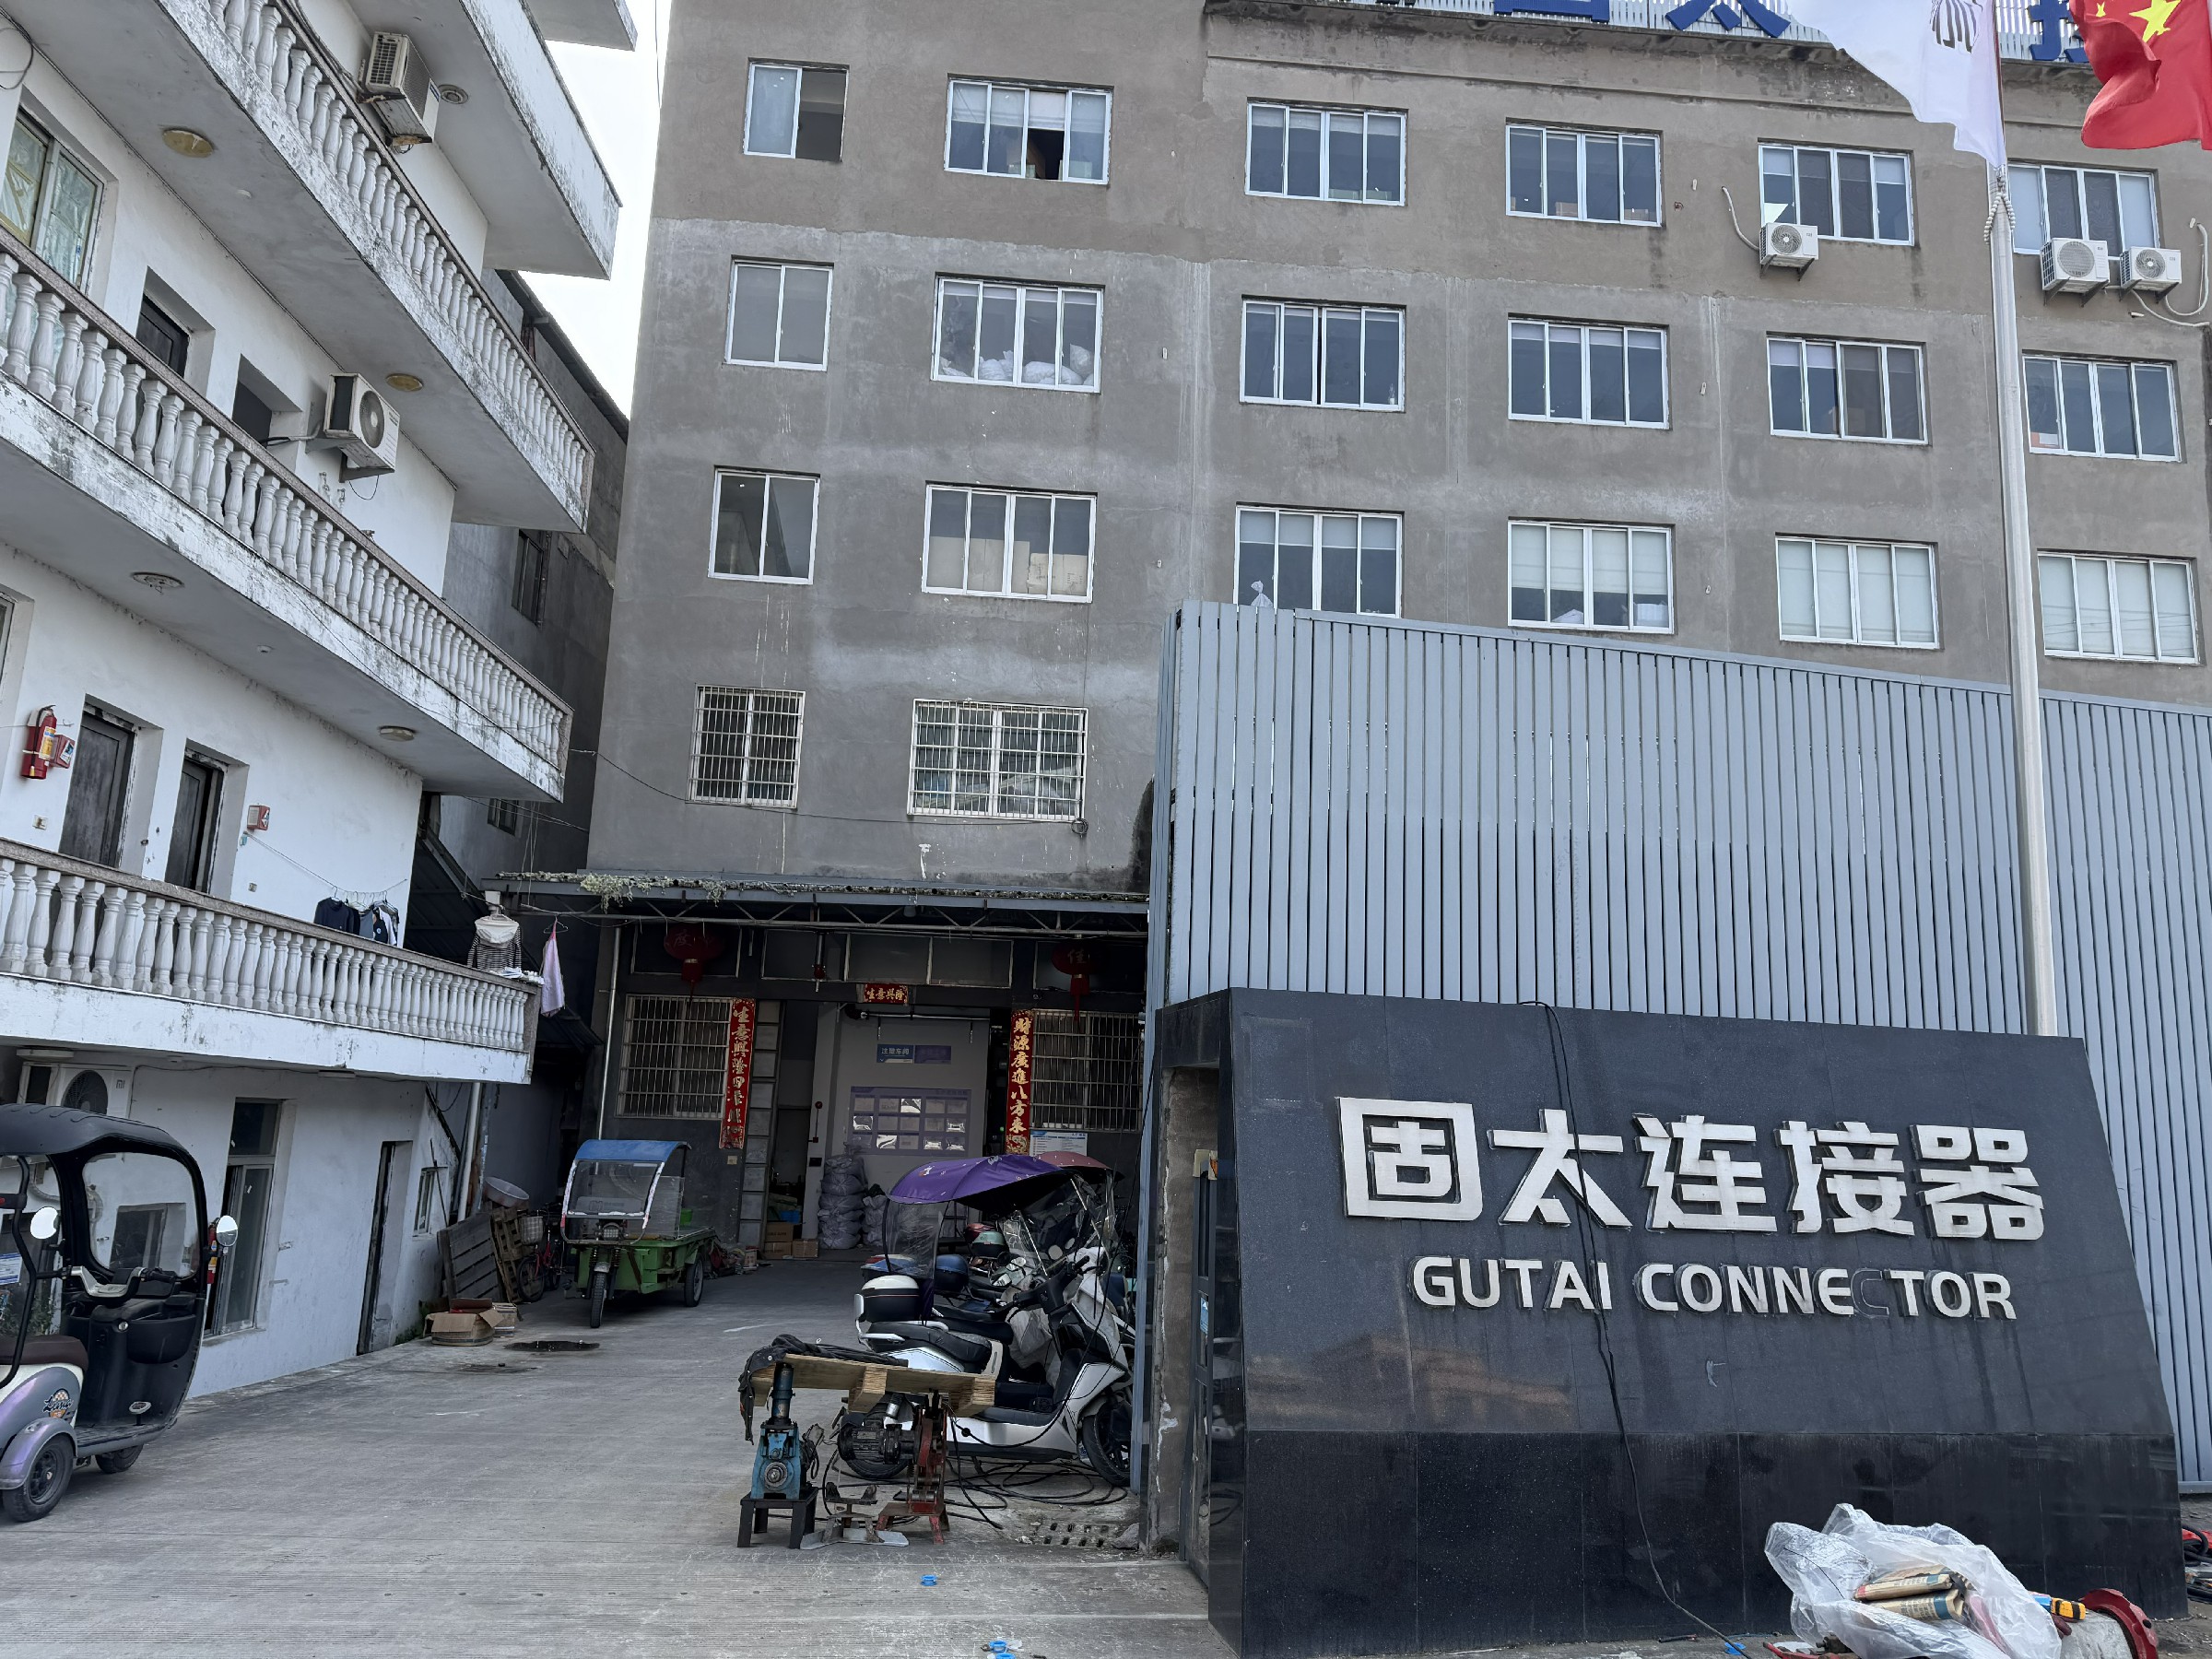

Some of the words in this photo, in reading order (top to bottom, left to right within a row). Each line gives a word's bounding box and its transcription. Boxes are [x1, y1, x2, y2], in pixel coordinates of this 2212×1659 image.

[1009, 1017, 1032, 1135] 財源廣進八方來
[1336, 1095, 2045, 1241] 固太连接器
[1410, 1256, 1613, 1312] GUTAI
